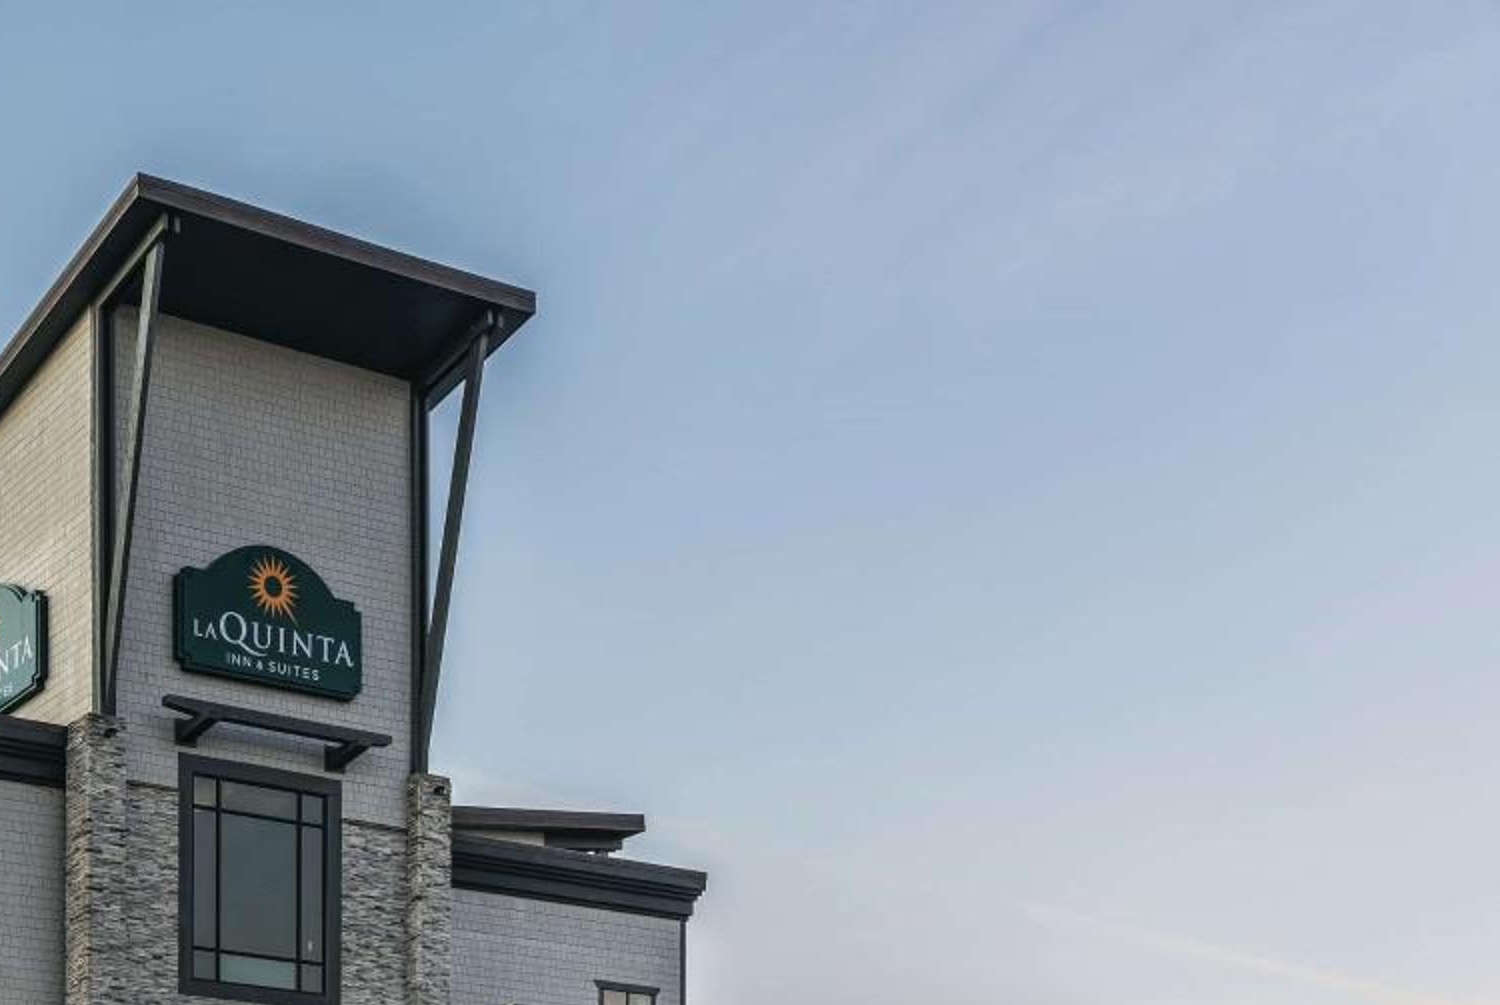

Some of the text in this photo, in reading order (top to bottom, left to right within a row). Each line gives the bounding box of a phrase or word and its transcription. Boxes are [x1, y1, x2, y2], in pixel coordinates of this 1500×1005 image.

[193, 611, 355, 667] LA QUINTA
[227, 652, 320, 681] INN & SUITES
